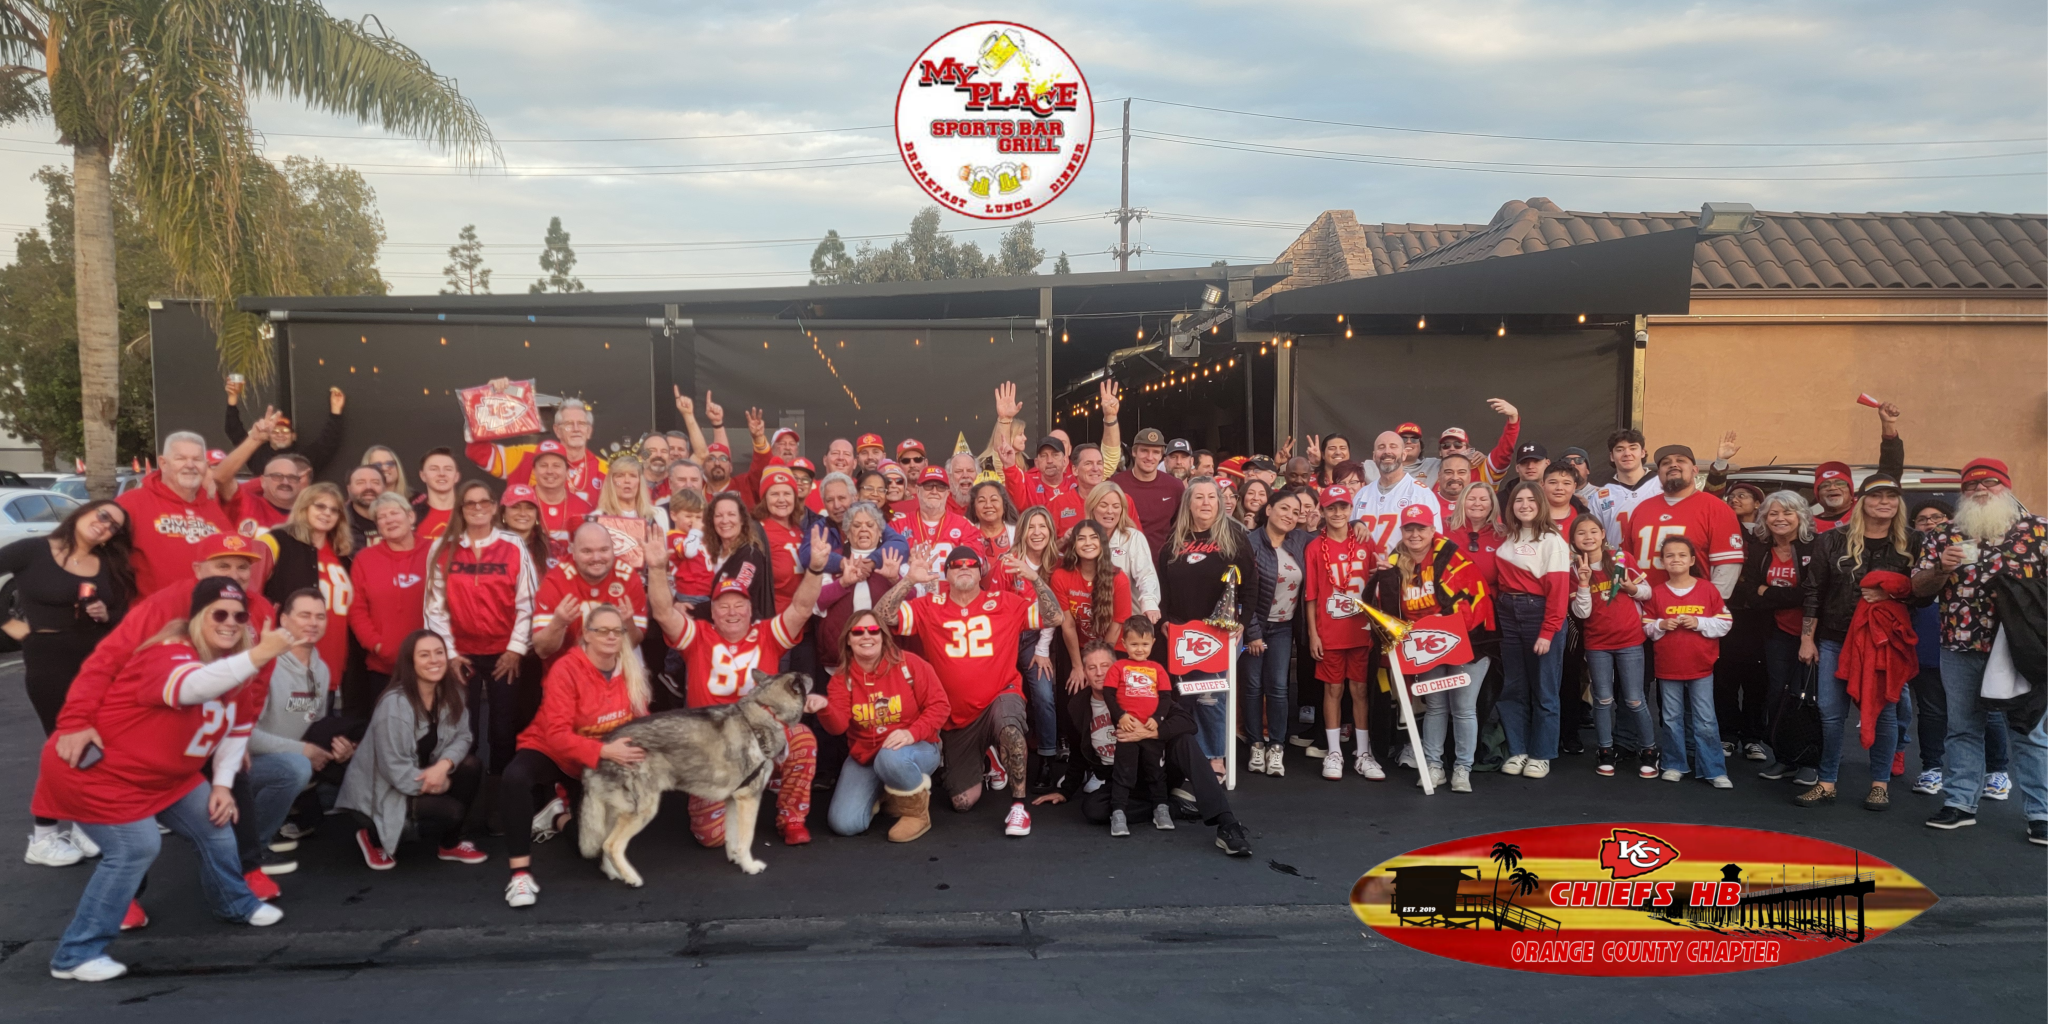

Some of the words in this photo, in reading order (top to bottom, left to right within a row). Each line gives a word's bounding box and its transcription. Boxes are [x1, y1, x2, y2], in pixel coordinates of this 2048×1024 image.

[449, 562, 508, 575] CHIEFS
[1767, 567, 1796, 578] HIEF
[1329, 561, 1366, 600] 15
[1665, 605, 1705, 615] CHIEFS
[943, 614, 994, 658] 32
[1414, 635, 1447, 654] KC
[1186, 638, 1211, 656] KC
[707, 643, 761, 697] 87
[1183, 683, 1194, 692] GO
[1195, 680, 1226, 691] CHIEFS
[1416, 684, 1428, 694] GO
[1430, 675, 1466, 691] CHIEFS
[597, 711, 617, 724] THIS
[184, 700, 237, 757] 21
